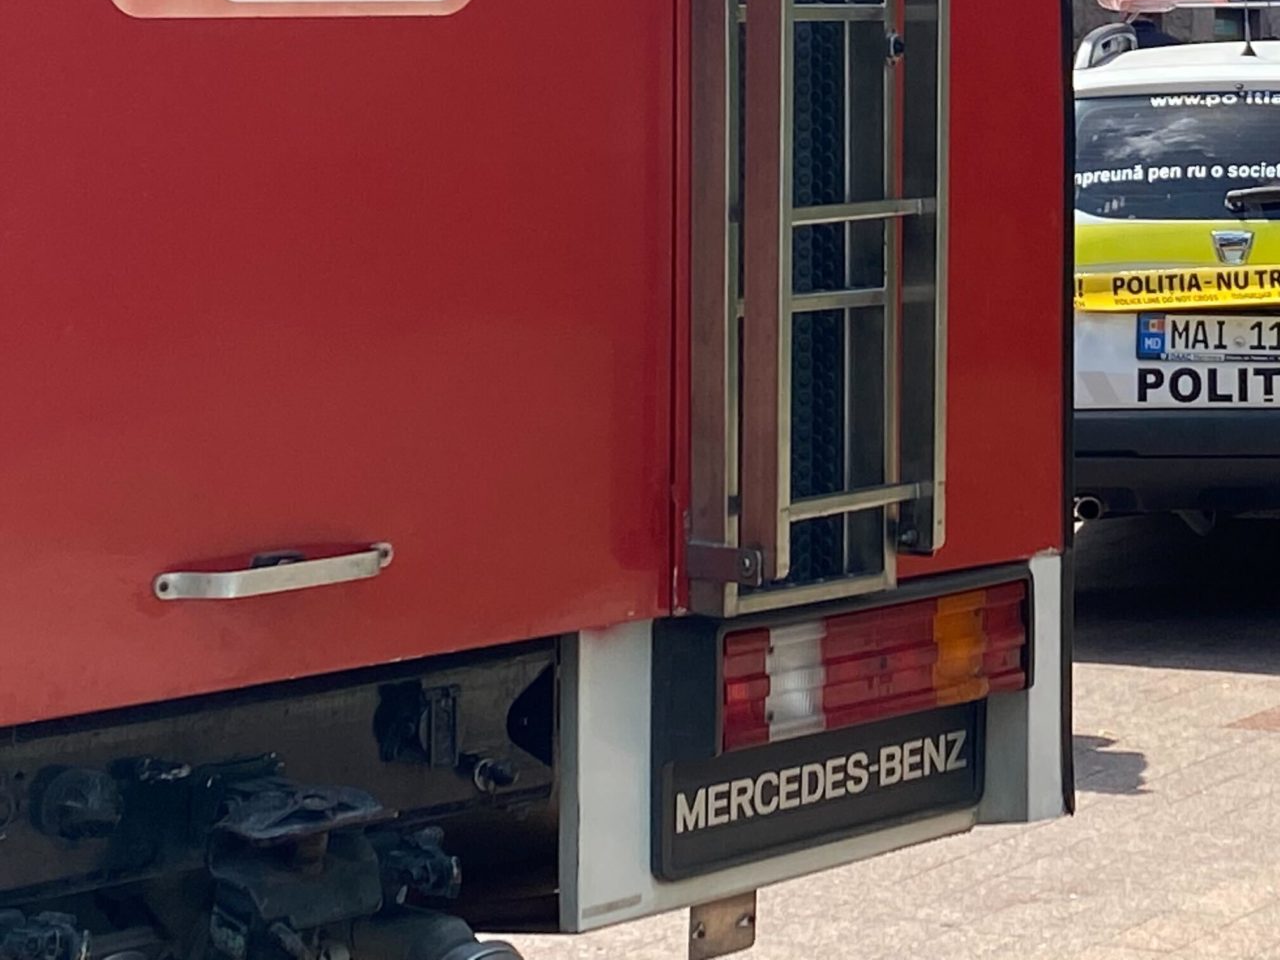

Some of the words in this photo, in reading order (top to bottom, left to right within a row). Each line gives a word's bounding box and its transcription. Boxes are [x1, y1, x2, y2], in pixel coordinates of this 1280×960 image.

[1211, 165, 1224, 178] o
[1144, 337, 1161, 350] MD
[1171, 320, 1228, 350] MAI
[675, 729, 967, 835] MERCEDES-BENZ
